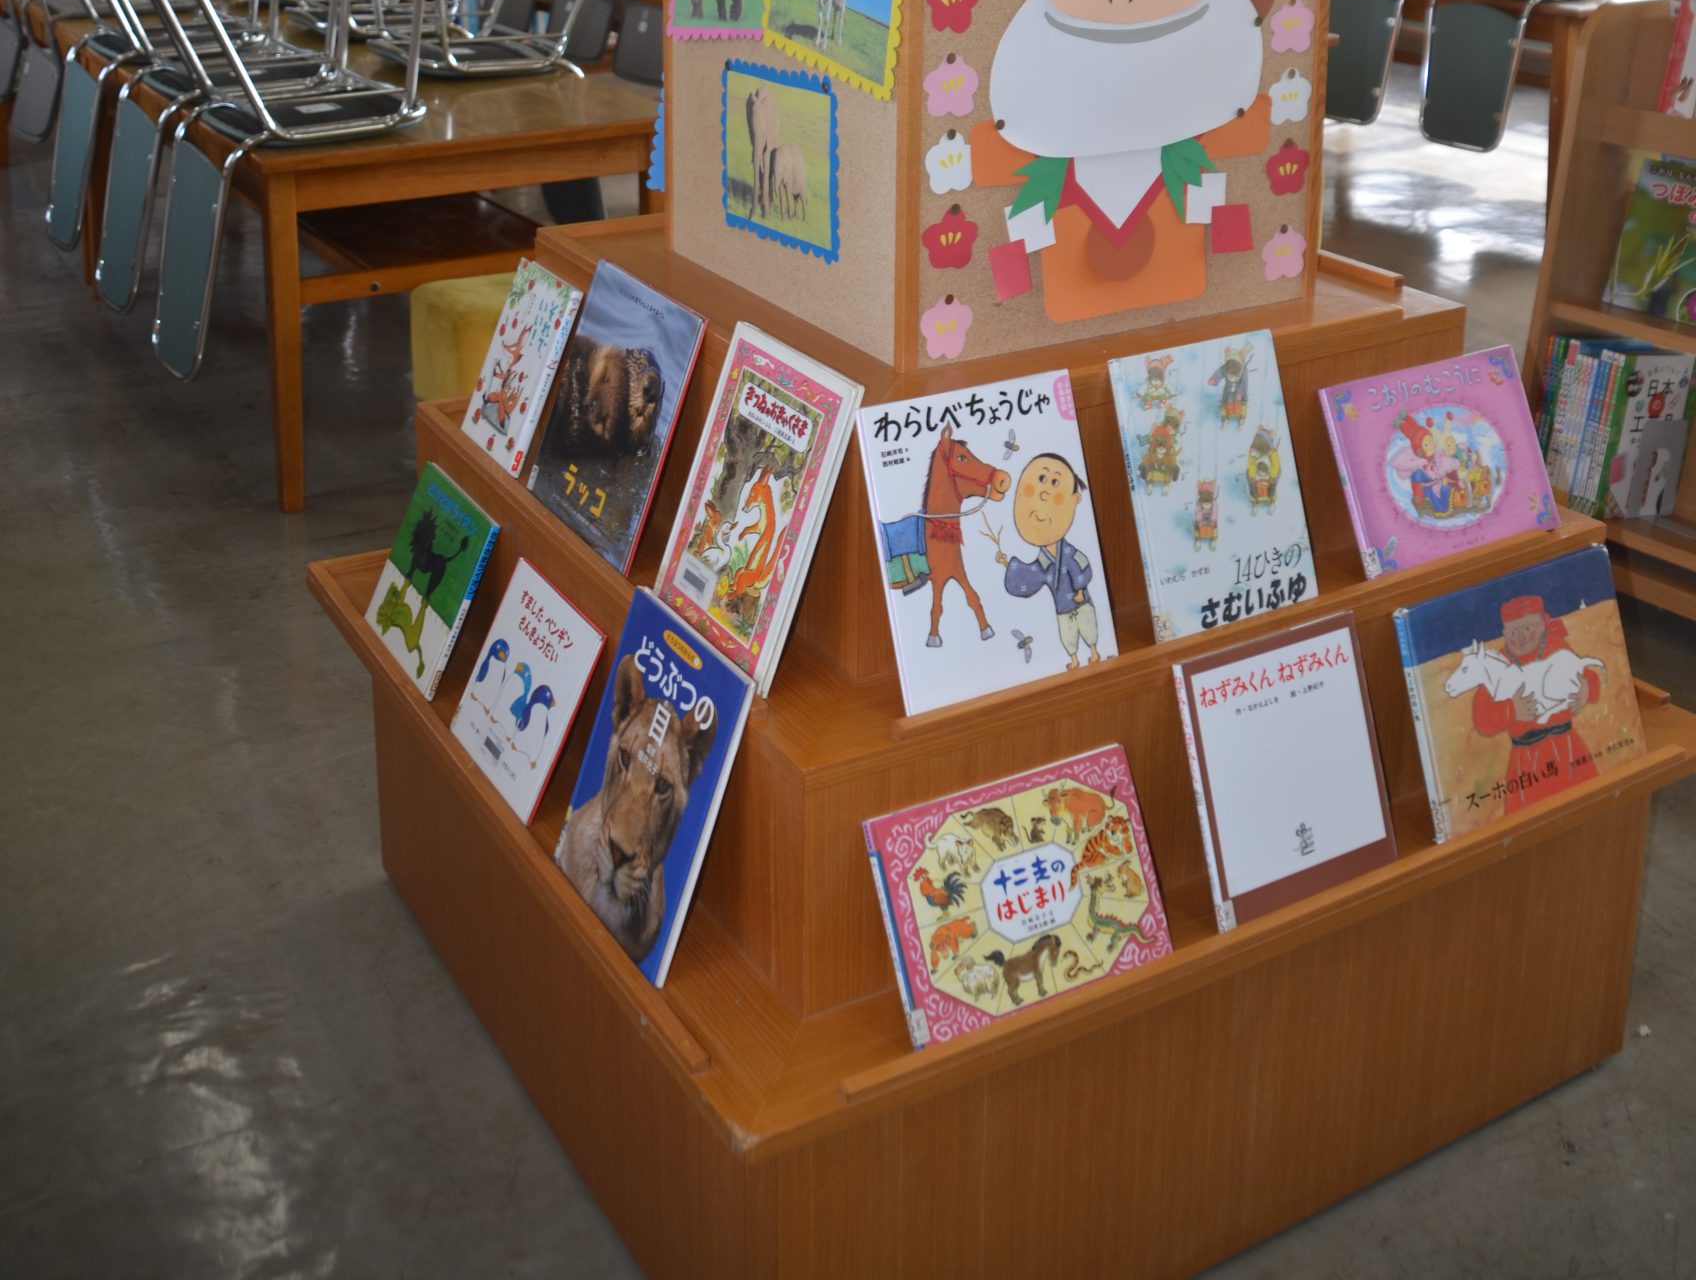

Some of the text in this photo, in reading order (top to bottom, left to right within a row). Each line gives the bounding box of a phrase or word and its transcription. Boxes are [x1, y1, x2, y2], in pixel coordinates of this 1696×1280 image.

[744, 385, 809, 440] きつねのおきゃくさま
[1367, 364, 1482, 411] こおりのむこうに
[873, 388, 1051, 442] わらしべちょうじゃ
[563, 463, 607, 518] ラッコ
[1233, 544, 1302, 585] 14ひきの
[520, 589, 574, 650] すました ペンギン
[1201, 572, 1307, 629] さむいふゆ
[518, 615, 559, 664] さんきょうだい
[633, 635, 715, 731] どうぶつの
[1199, 644, 1350, 709] ねずみくん ねずみくん
[648, 702, 671, 747] 目
[1465, 759, 1559, 812] スーホの白い馬
[993, 854, 1066, 894] 十二支の
[996, 880, 1066, 922] はじまり
